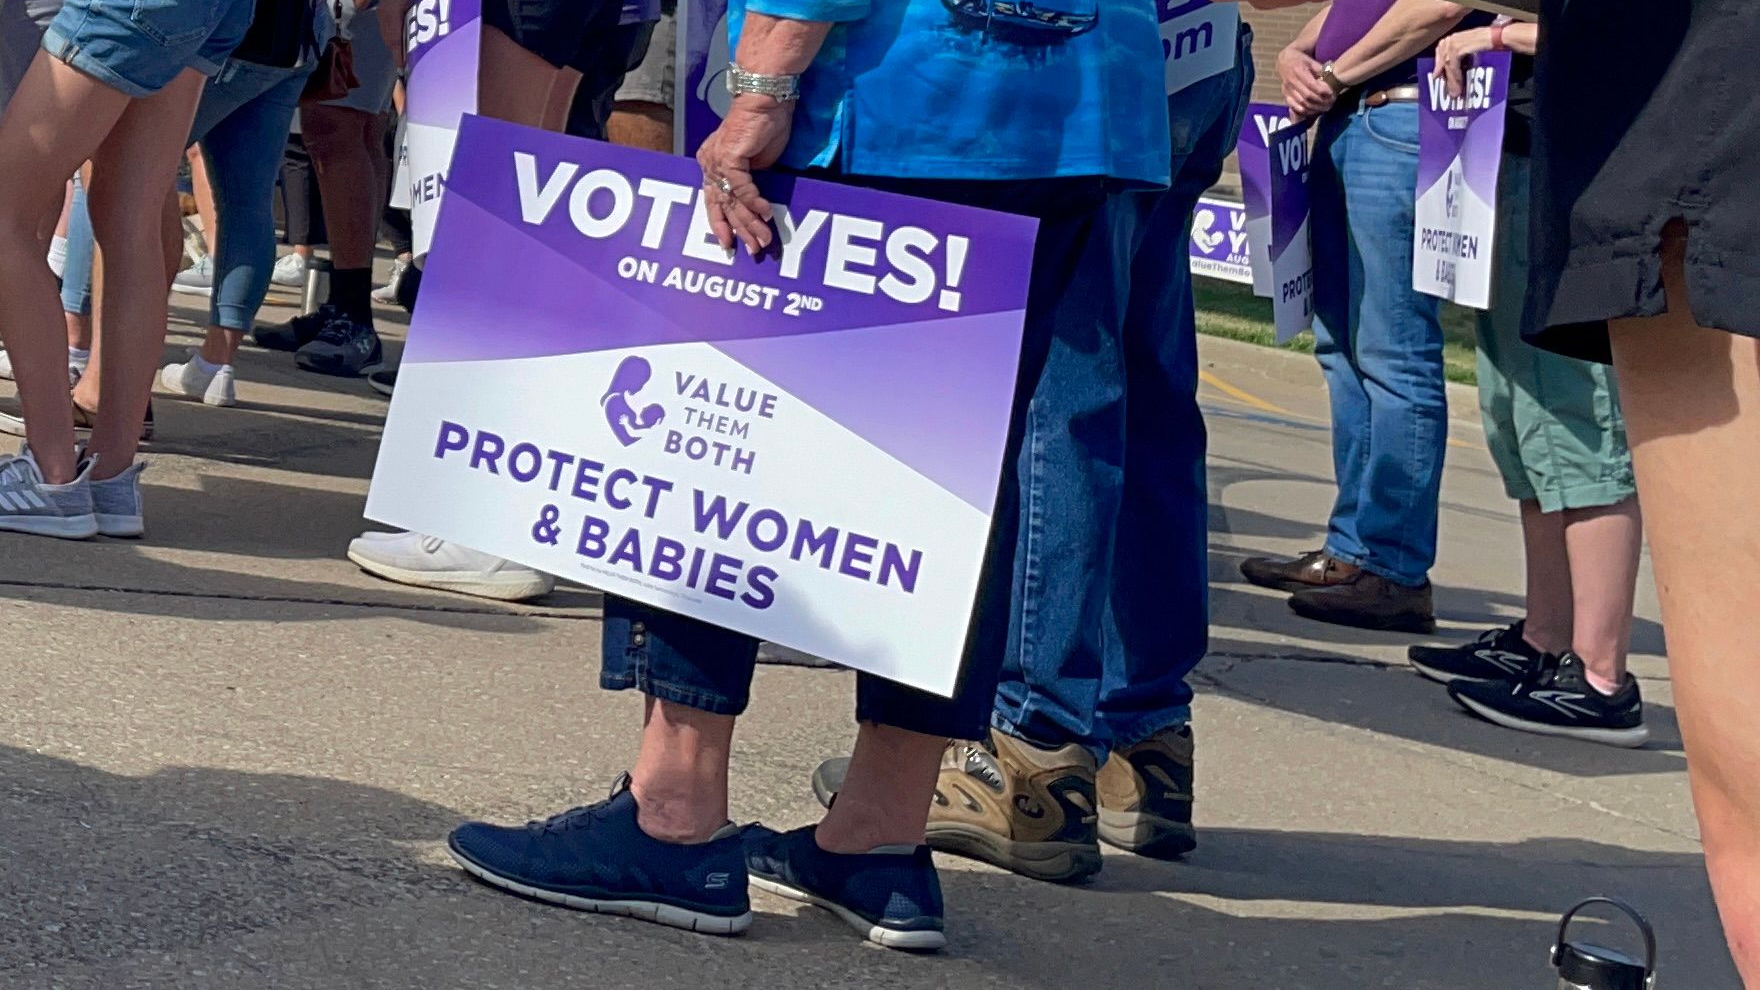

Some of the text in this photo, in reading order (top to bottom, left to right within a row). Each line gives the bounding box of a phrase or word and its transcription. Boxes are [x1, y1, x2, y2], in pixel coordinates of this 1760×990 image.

[617, 256, 823, 316] ON AUGUST 2ND
[771, 203, 970, 312] YES!
[674, 371, 779, 420] VALUE
[683, 407, 750, 440] THEM
[663, 430, 756, 475] BOTH
[433, 420, 674, 518] PROTECT
[691, 489, 924, 594] WOMEN
[531, 504, 563, 546] &
[575, 515, 779, 610] BABIES
